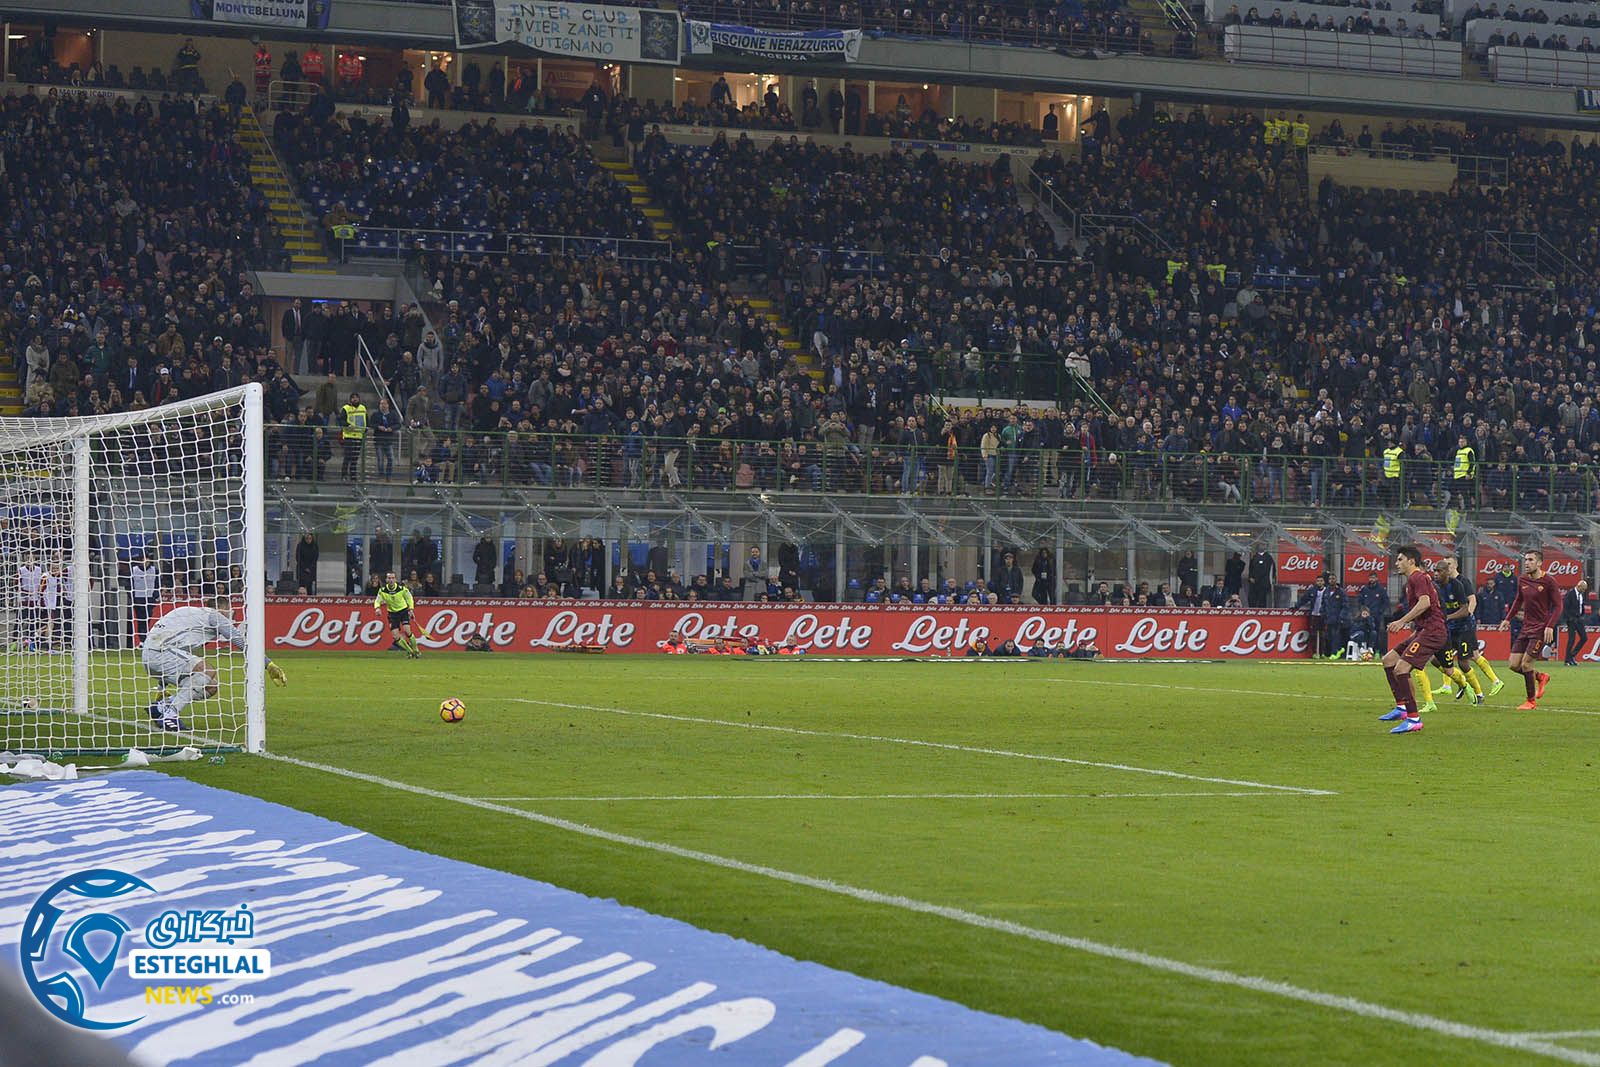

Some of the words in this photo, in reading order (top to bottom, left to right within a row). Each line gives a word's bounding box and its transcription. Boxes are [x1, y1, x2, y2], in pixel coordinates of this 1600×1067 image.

[215, 2, 305, 19] MONTEBELLUNA
[511, 3, 570, 19] INTER
[582, 9, 628, 22] CLUB
[526, 36, 614, 54] PUTIGNANO
[711, 31, 766, 50] BISCIONE
[769, 38, 845, 52] NERAZZURRO
[1281, 555, 1319, 571] Lete
[1348, 556, 1385, 572] Lete
[1480, 559, 1515, 574] Lee
[1546, 561, 1579, 576] Lete
[274, 607, 384, 647] Lete
[416, 609, 516, 648] Lete
[530, 610, 634, 647] Lete
[774, 613, 872, 650] Lete
[892, 615, 990, 652] Lete
[1013, 616, 1097, 653] Lete
[1115, 617, 1208, 654] Lete
[1219, 619, 1309, 655] Lete
[1410, 642, 1420, 653] 8
